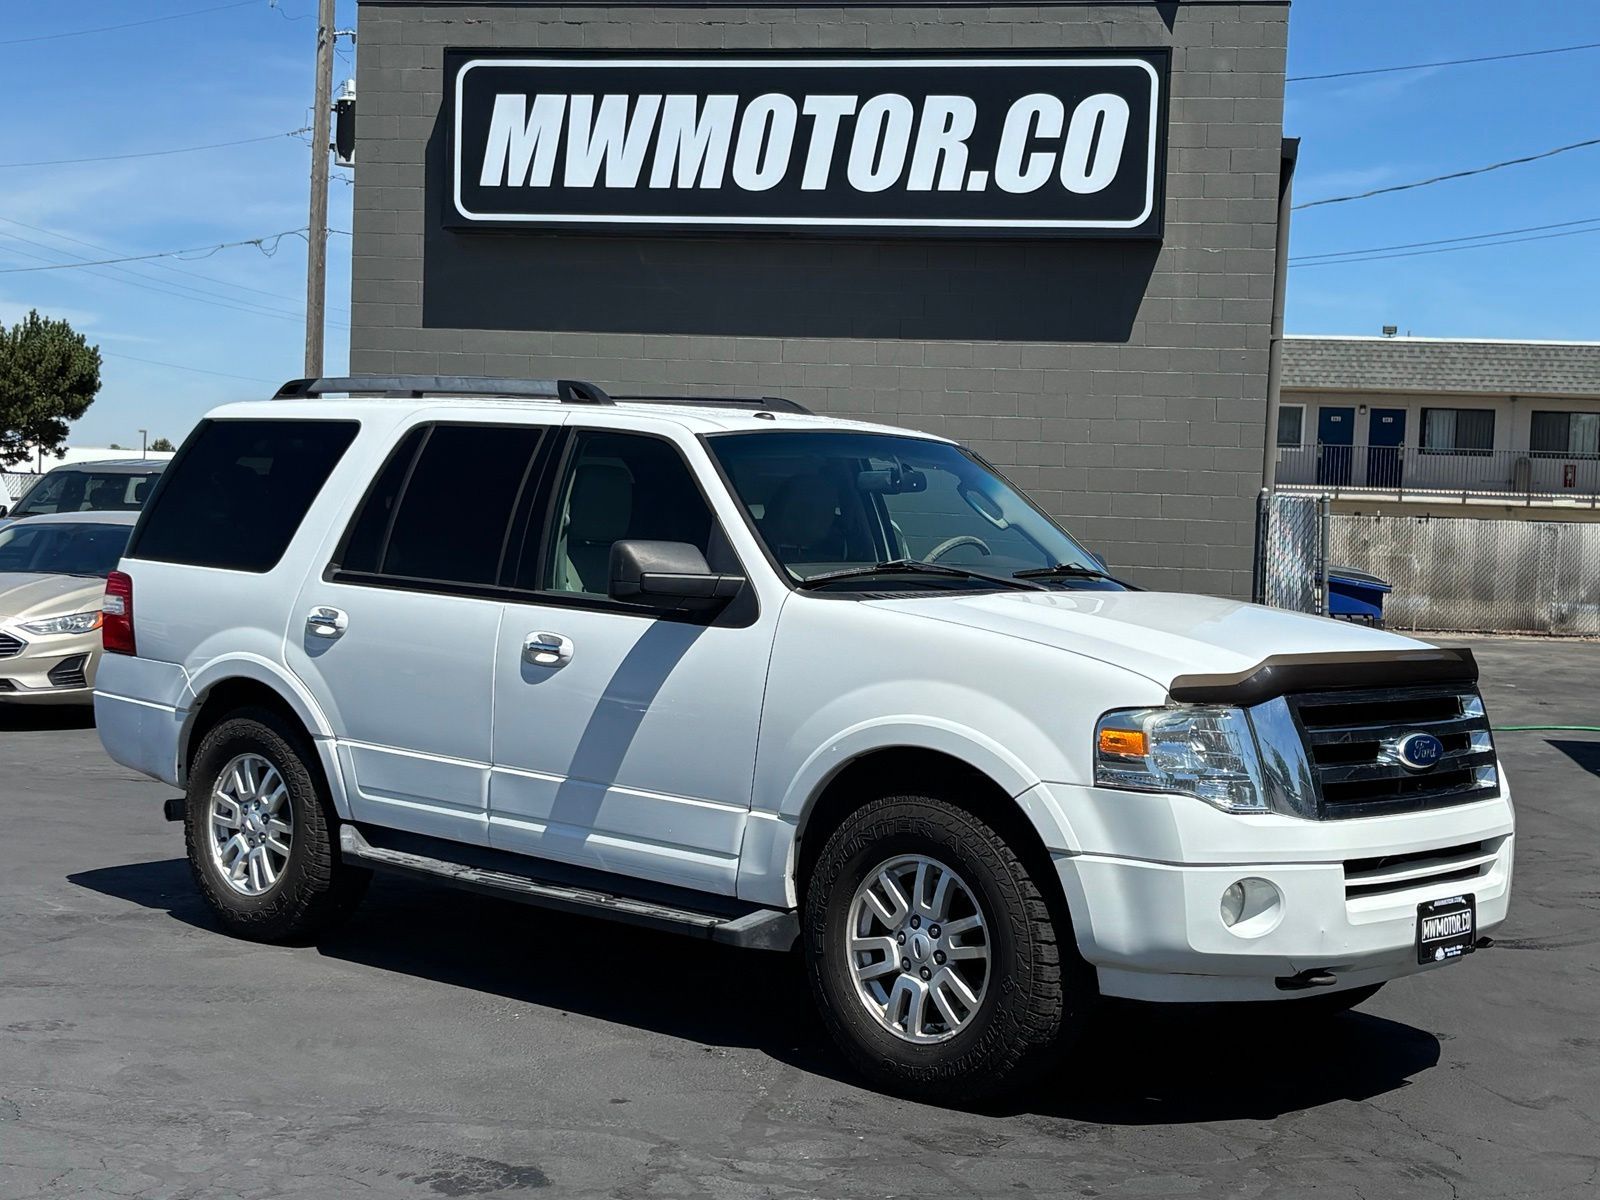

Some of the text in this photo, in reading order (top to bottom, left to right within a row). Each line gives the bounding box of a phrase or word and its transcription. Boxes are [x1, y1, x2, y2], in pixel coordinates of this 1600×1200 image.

[479, 93, 1129, 194] MWMOTOR.CO
[1413, 740, 1436, 760] Ford
[1423, 912, 1471, 940] MWMOTOR.CO
